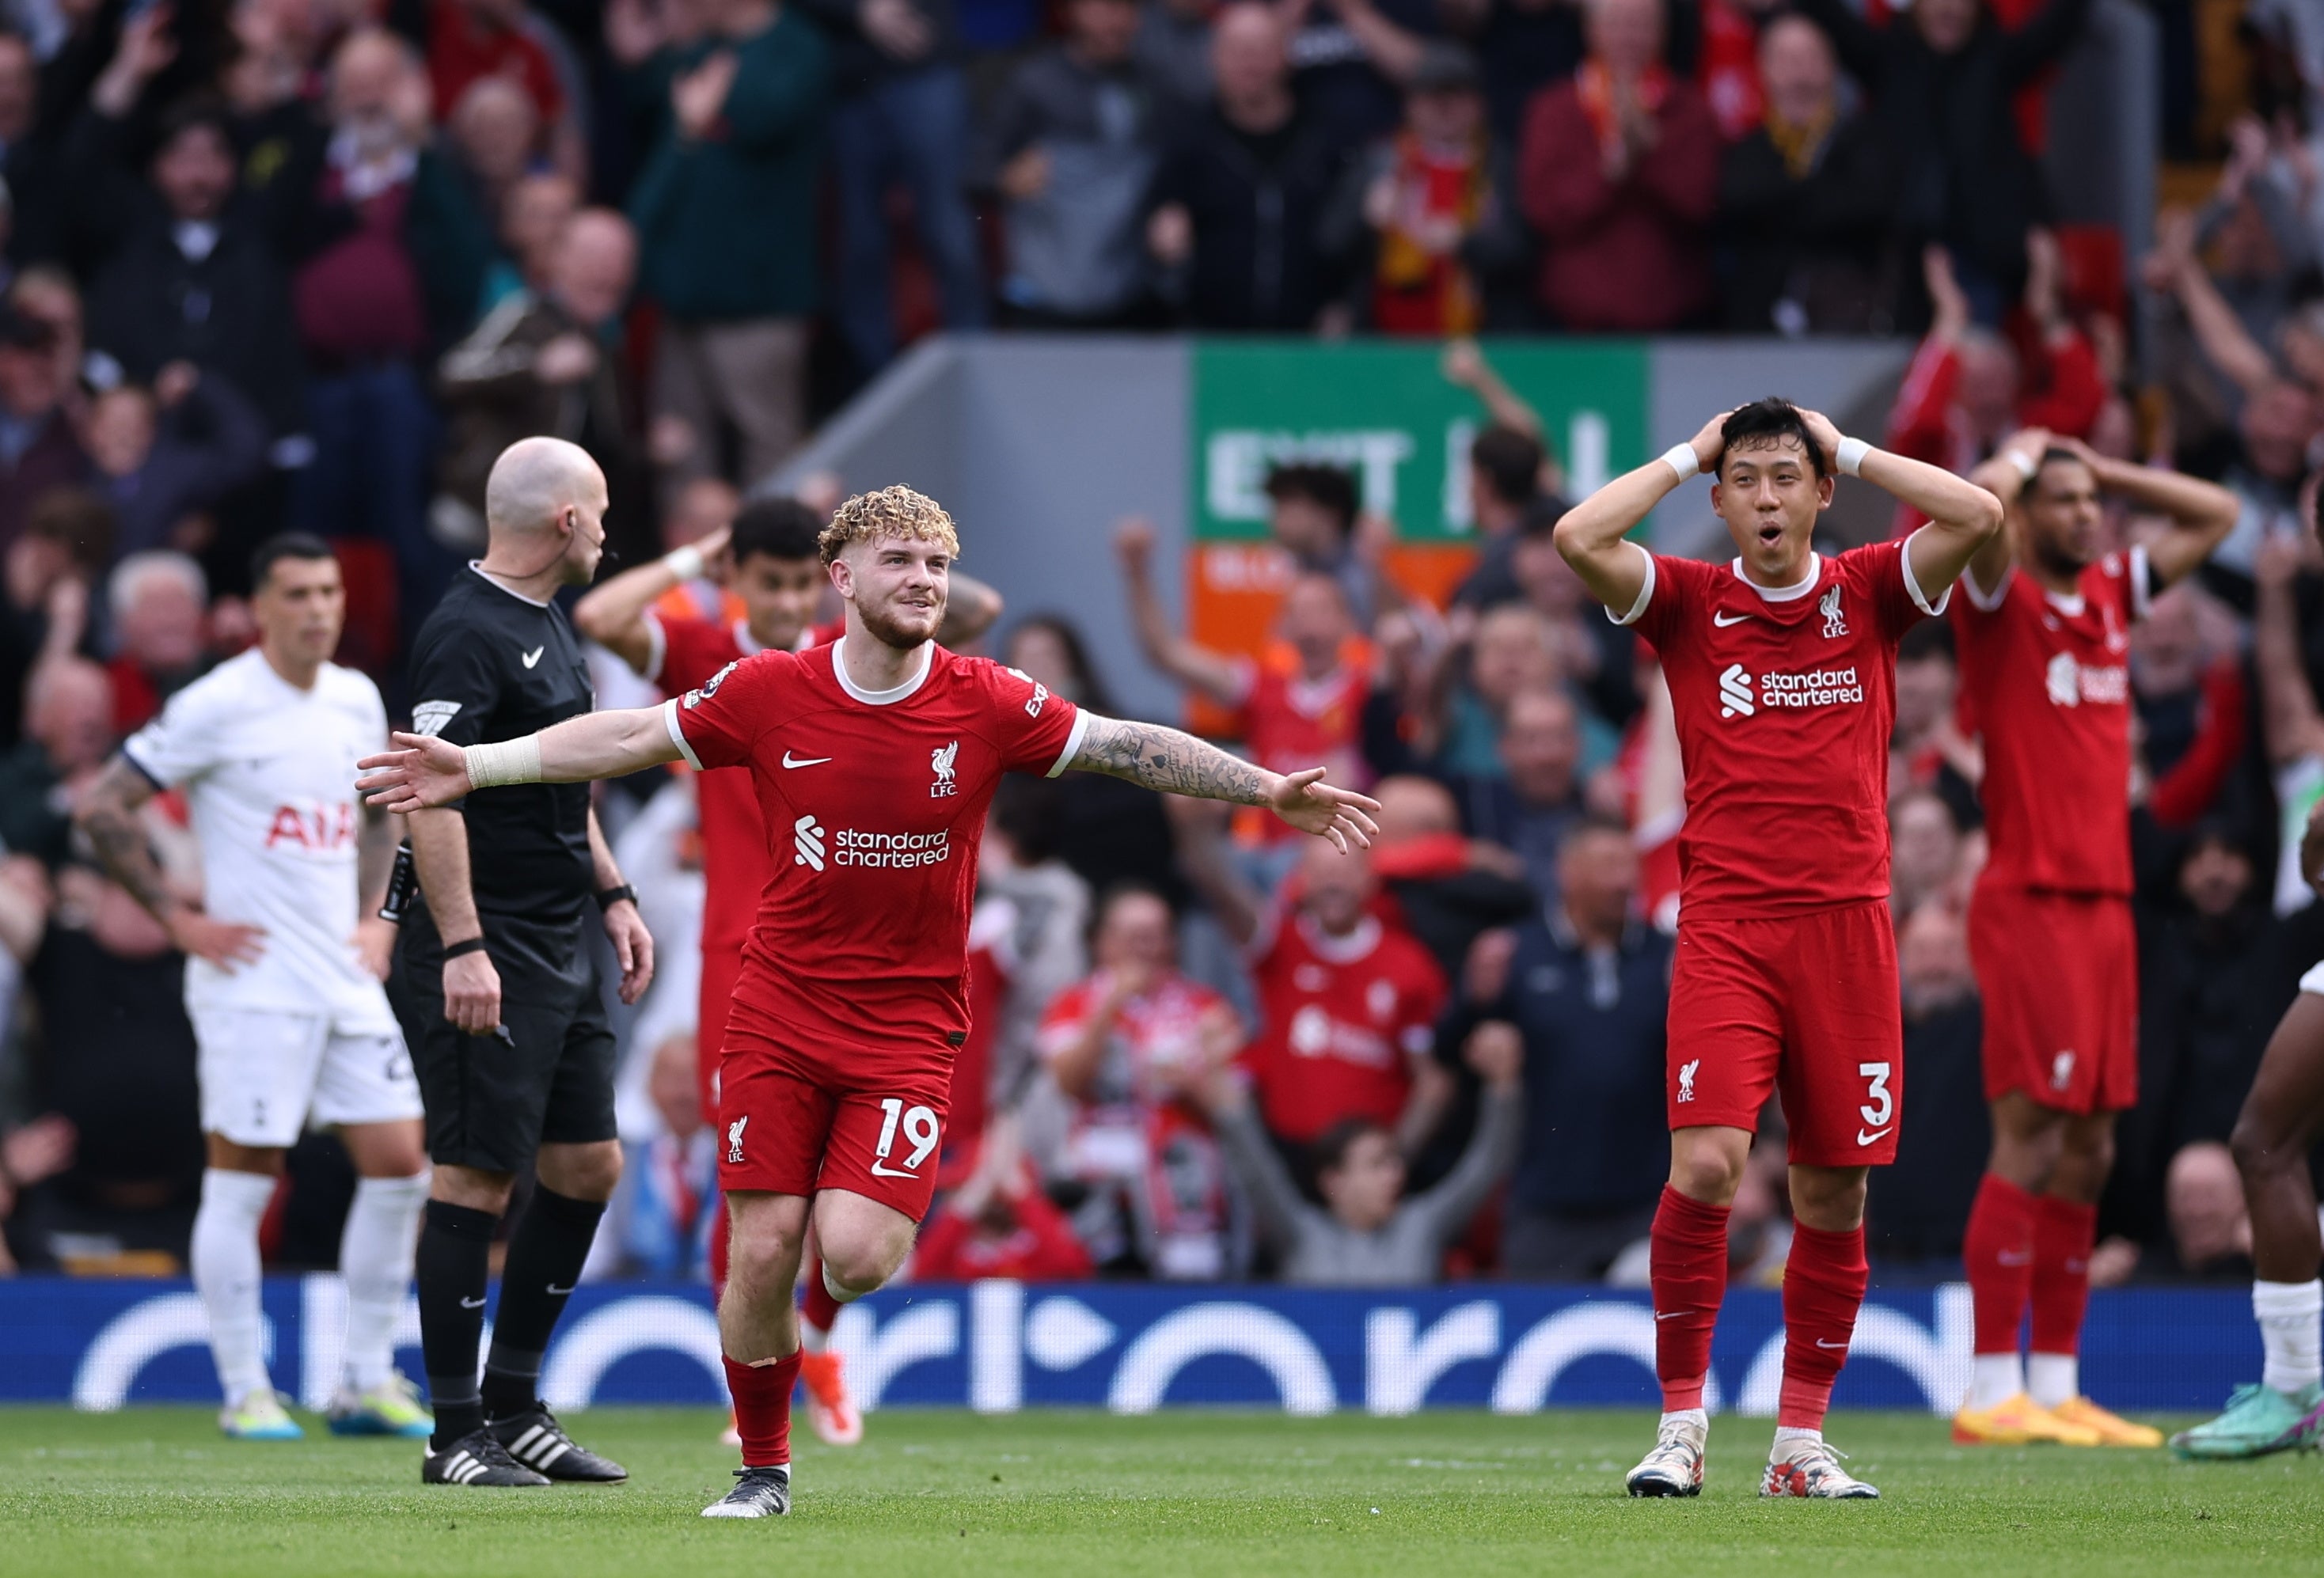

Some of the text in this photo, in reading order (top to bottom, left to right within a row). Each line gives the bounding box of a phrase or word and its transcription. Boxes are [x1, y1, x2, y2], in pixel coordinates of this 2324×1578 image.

[1207, 431, 1415, 519] ET
[1761, 666, 1856, 690] standard
[1763, 684, 1863, 707] chartered
[836, 828, 949, 850] standard
[835, 843, 950, 868] chartered
[1859, 1062, 1892, 1127] 3
[875, 1098, 939, 1170] 19
